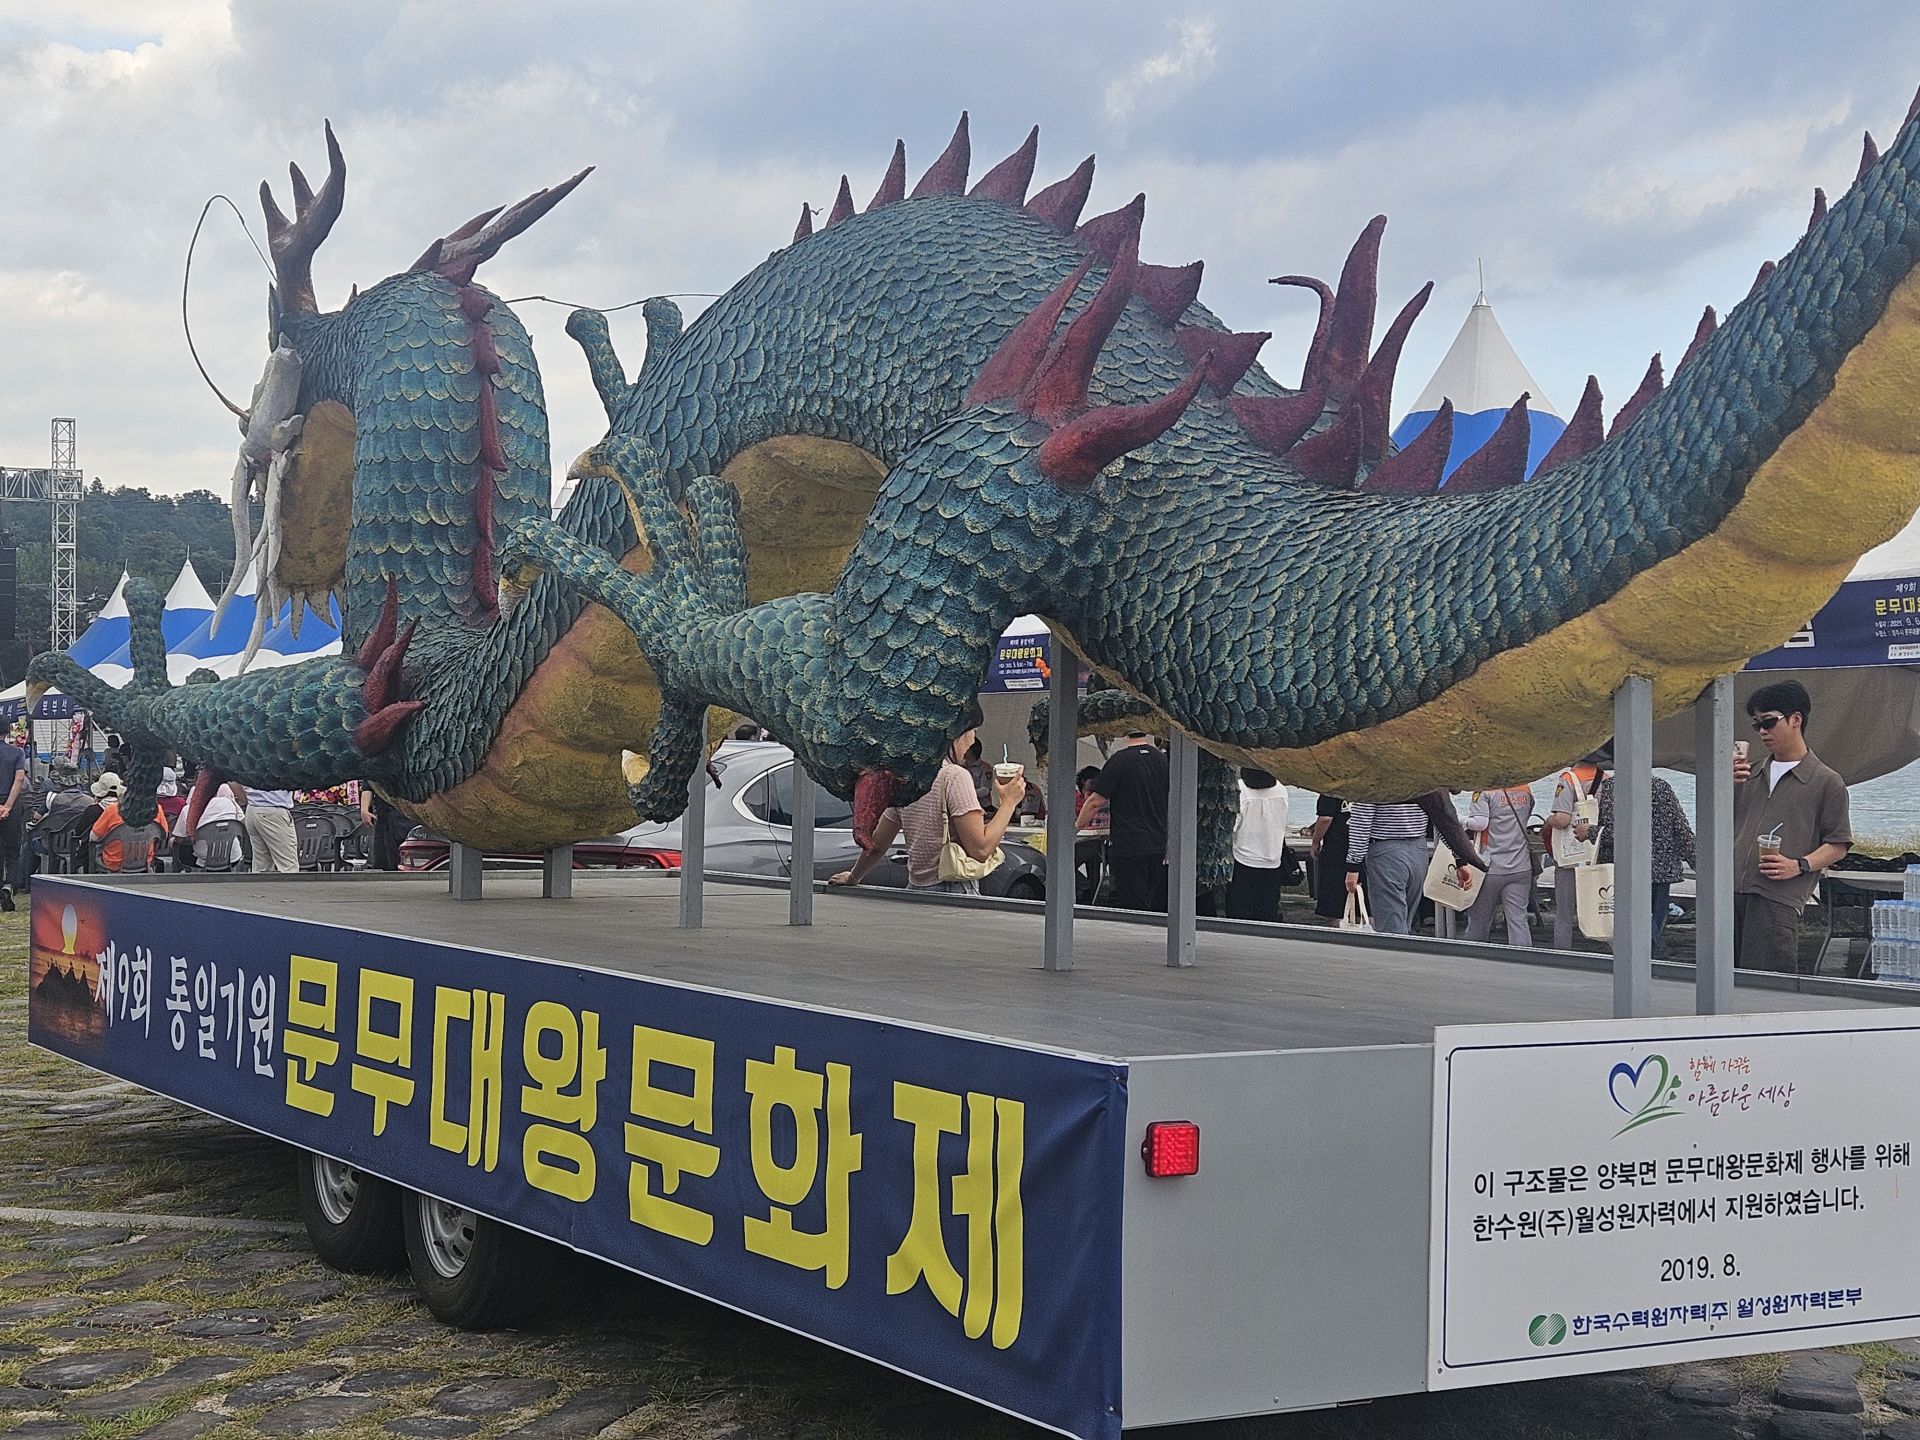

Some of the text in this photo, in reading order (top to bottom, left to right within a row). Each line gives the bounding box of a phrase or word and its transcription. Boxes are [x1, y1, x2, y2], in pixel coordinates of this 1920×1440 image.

[1895, 582, 1917, 594] 제9회
[1875, 596, 1920, 616] 문무대
[1688, 1082, 1796, 1117] 아름다운 세상
[94, 939, 1023, 1348] 제9회 통일기원 문무대왕문화제
[1474, 1141, 1910, 1199] 이 구조물은 양북면 문무대왕문화제 행사를 위해
[1472, 1186, 1865, 1242] 한수원(주)월성원자력에서 지원하였습니다.
[1660, 1253, 1741, 1282] 2019. 8.
[1737, 1288, 1863, 1320] 월성원자력본부
